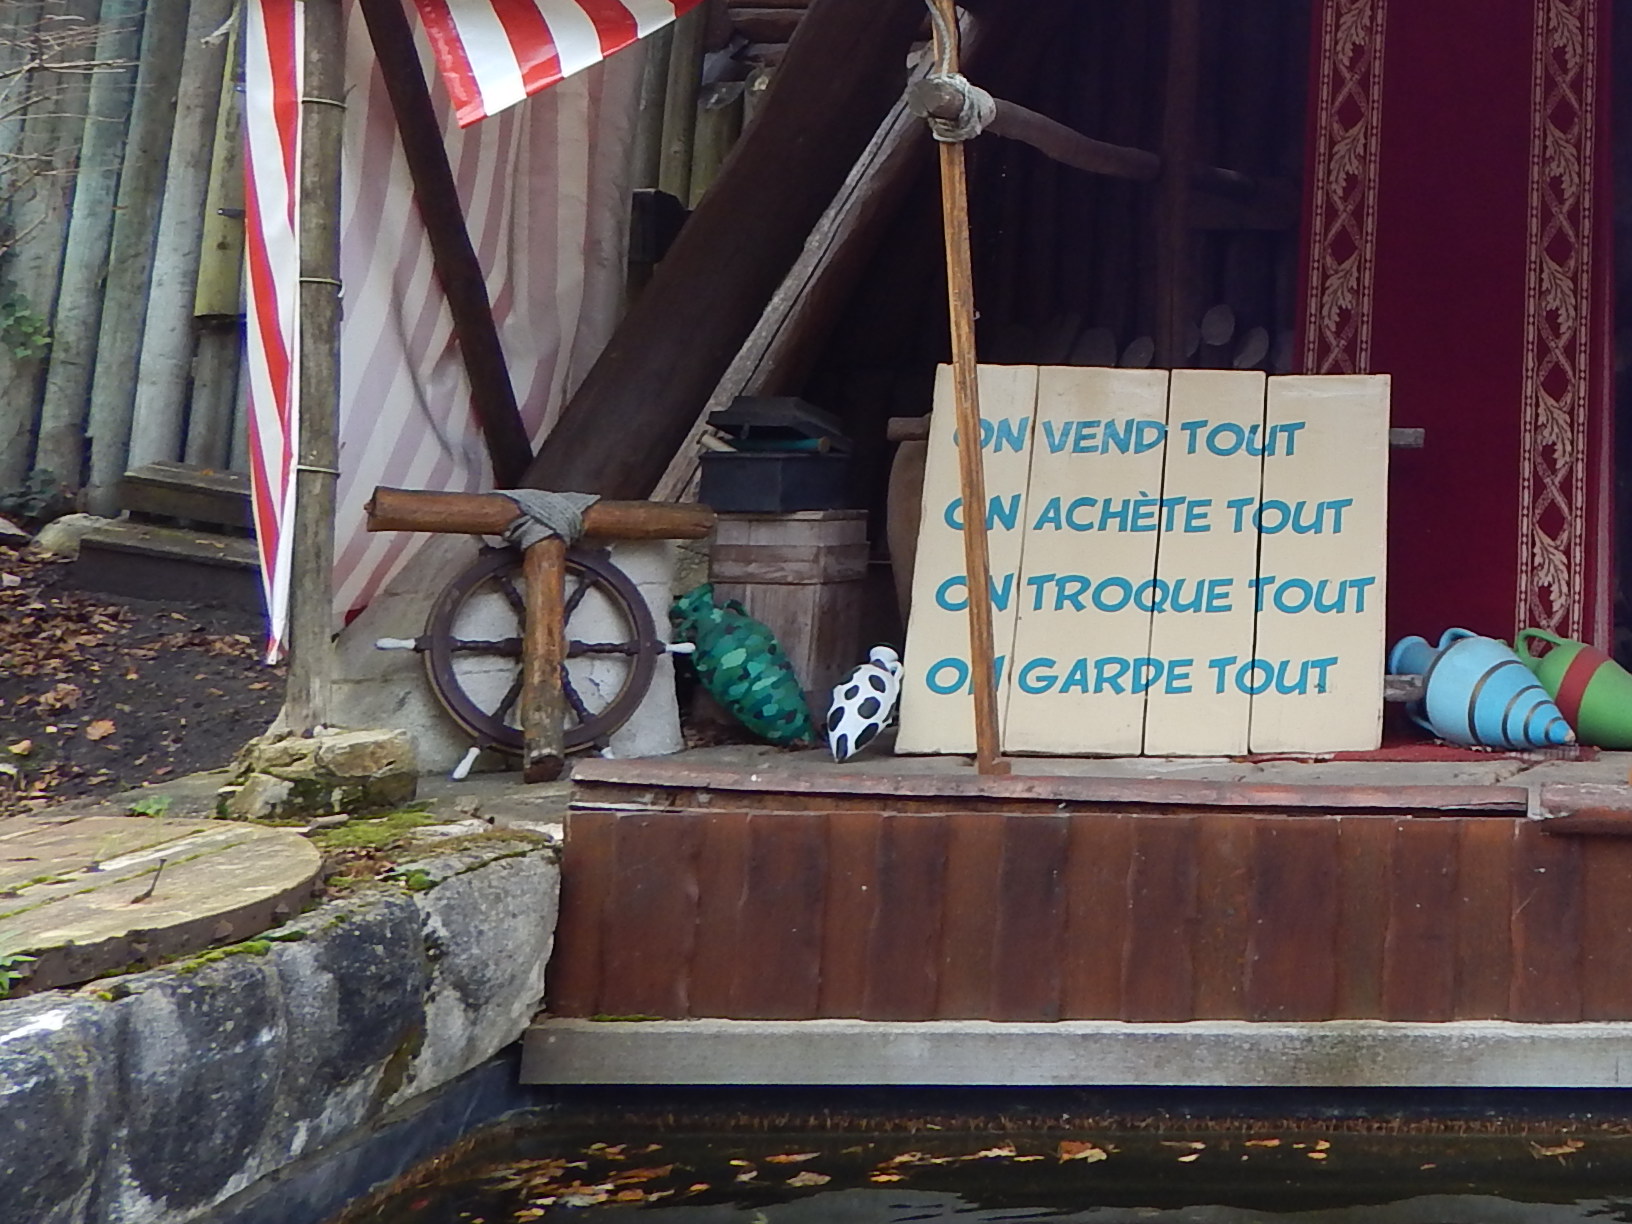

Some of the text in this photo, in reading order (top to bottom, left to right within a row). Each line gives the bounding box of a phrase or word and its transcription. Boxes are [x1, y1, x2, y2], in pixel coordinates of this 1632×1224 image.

[1041, 418, 1168, 455] VEND
[1181, 419, 1305, 457] TOUT
[1033, 490, 1212, 533] ACHÈTE
[1226, 497, 1353, 535] TOUT
[934, 572, 1376, 614] ON TROQUE TOUT
[1017, 656, 1193, 695] GARDE
[1207, 655, 1338, 695] TOUT
